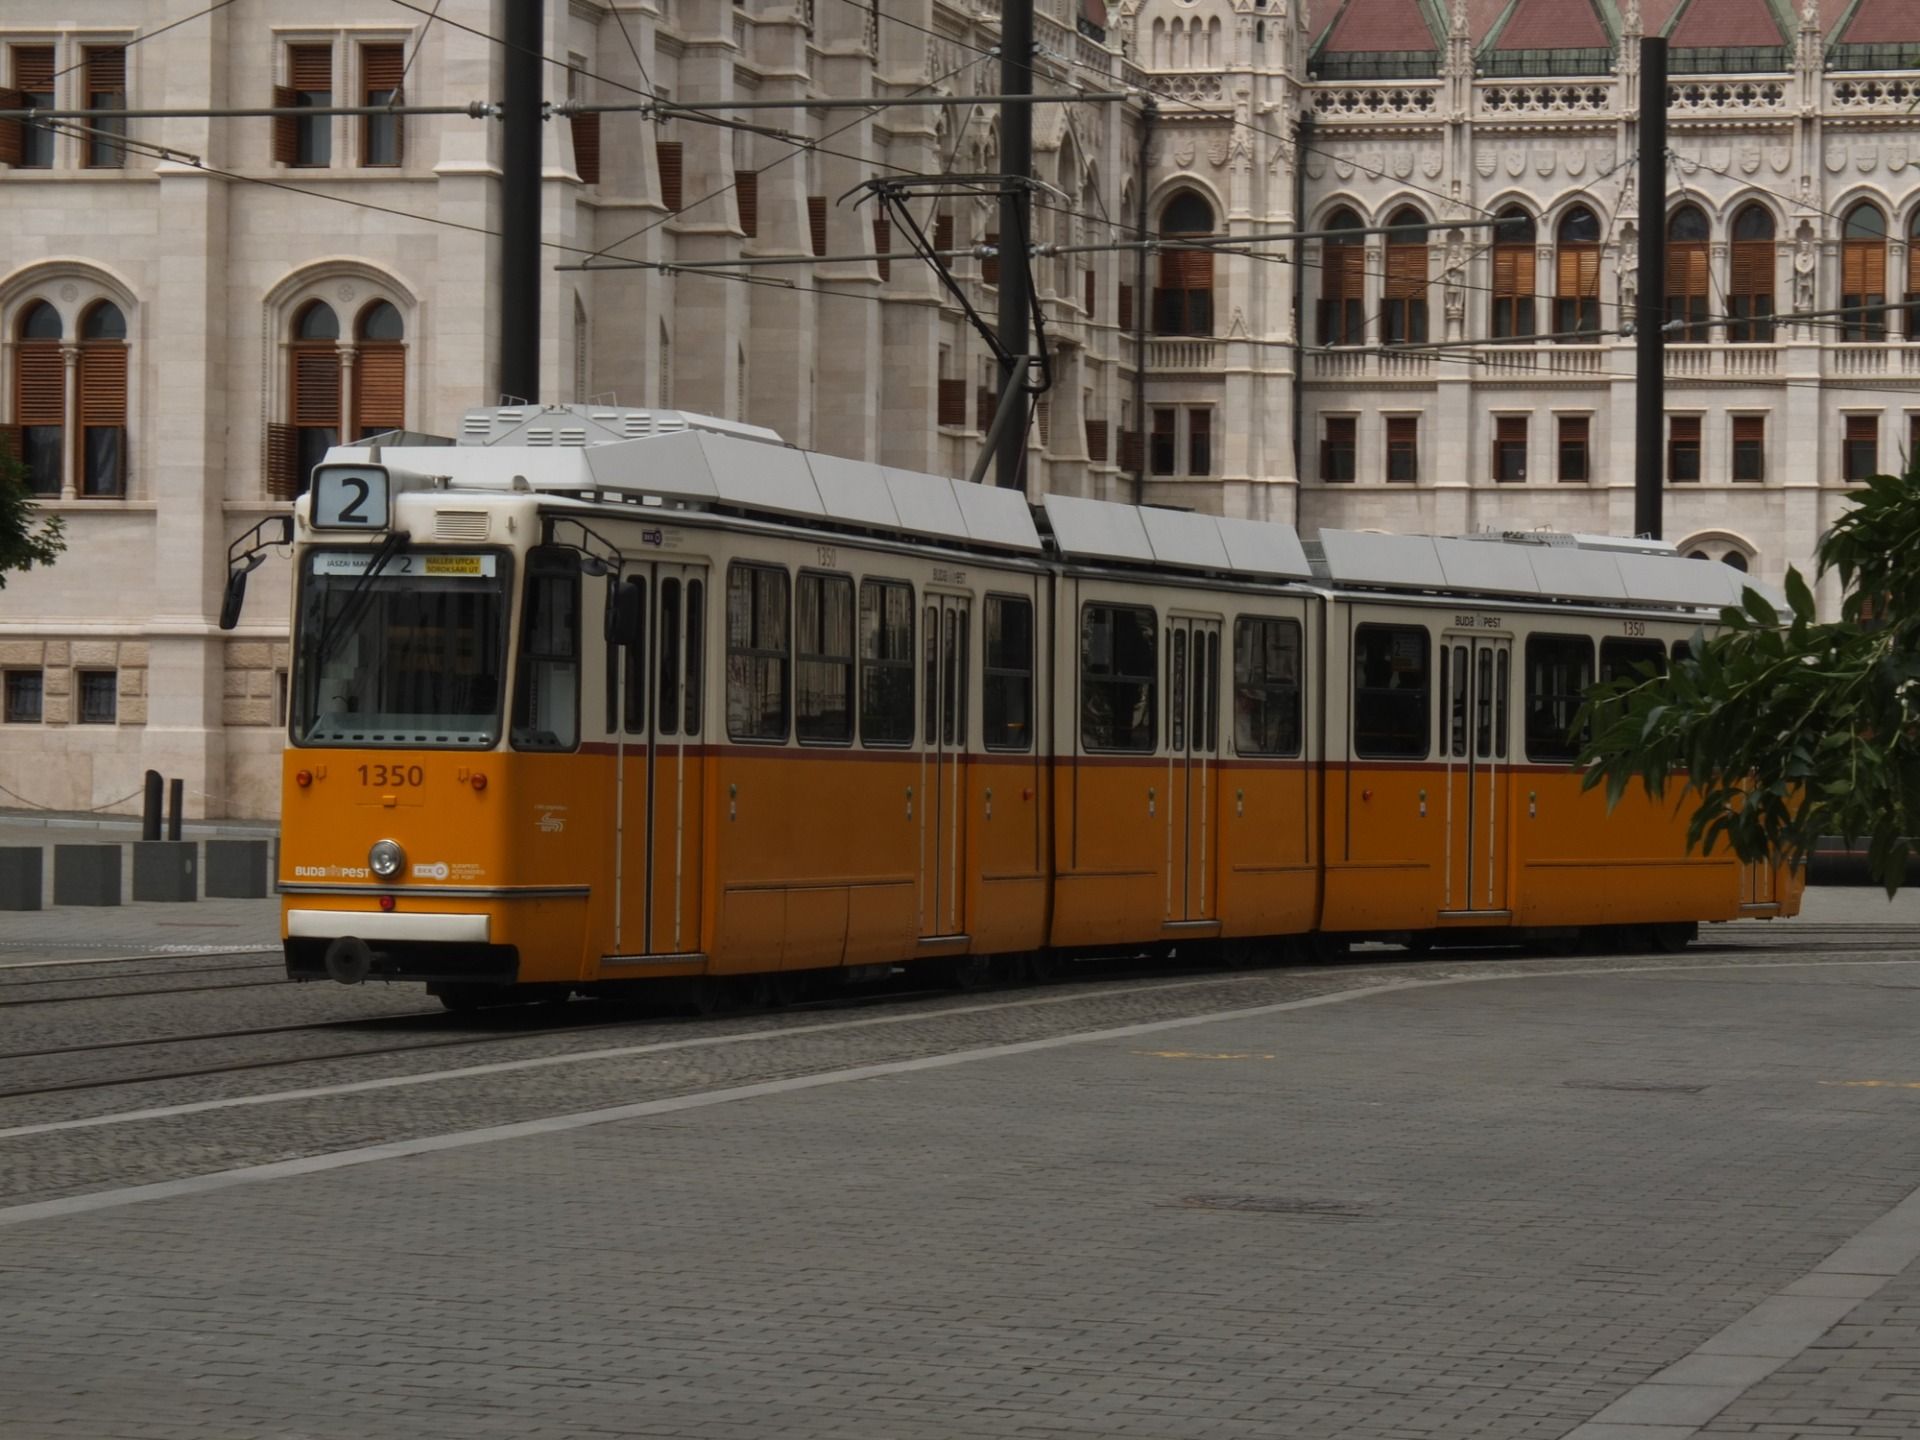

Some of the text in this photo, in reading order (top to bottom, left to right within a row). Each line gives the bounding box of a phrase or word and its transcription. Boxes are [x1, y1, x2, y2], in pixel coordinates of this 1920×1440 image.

[338, 477, 370, 523] 2
[400, 556, 412, 574] 2
[816, 546, 837, 568] 1350
[1623, 621, 1645, 636] 1350
[357, 764, 423, 787] 1350
